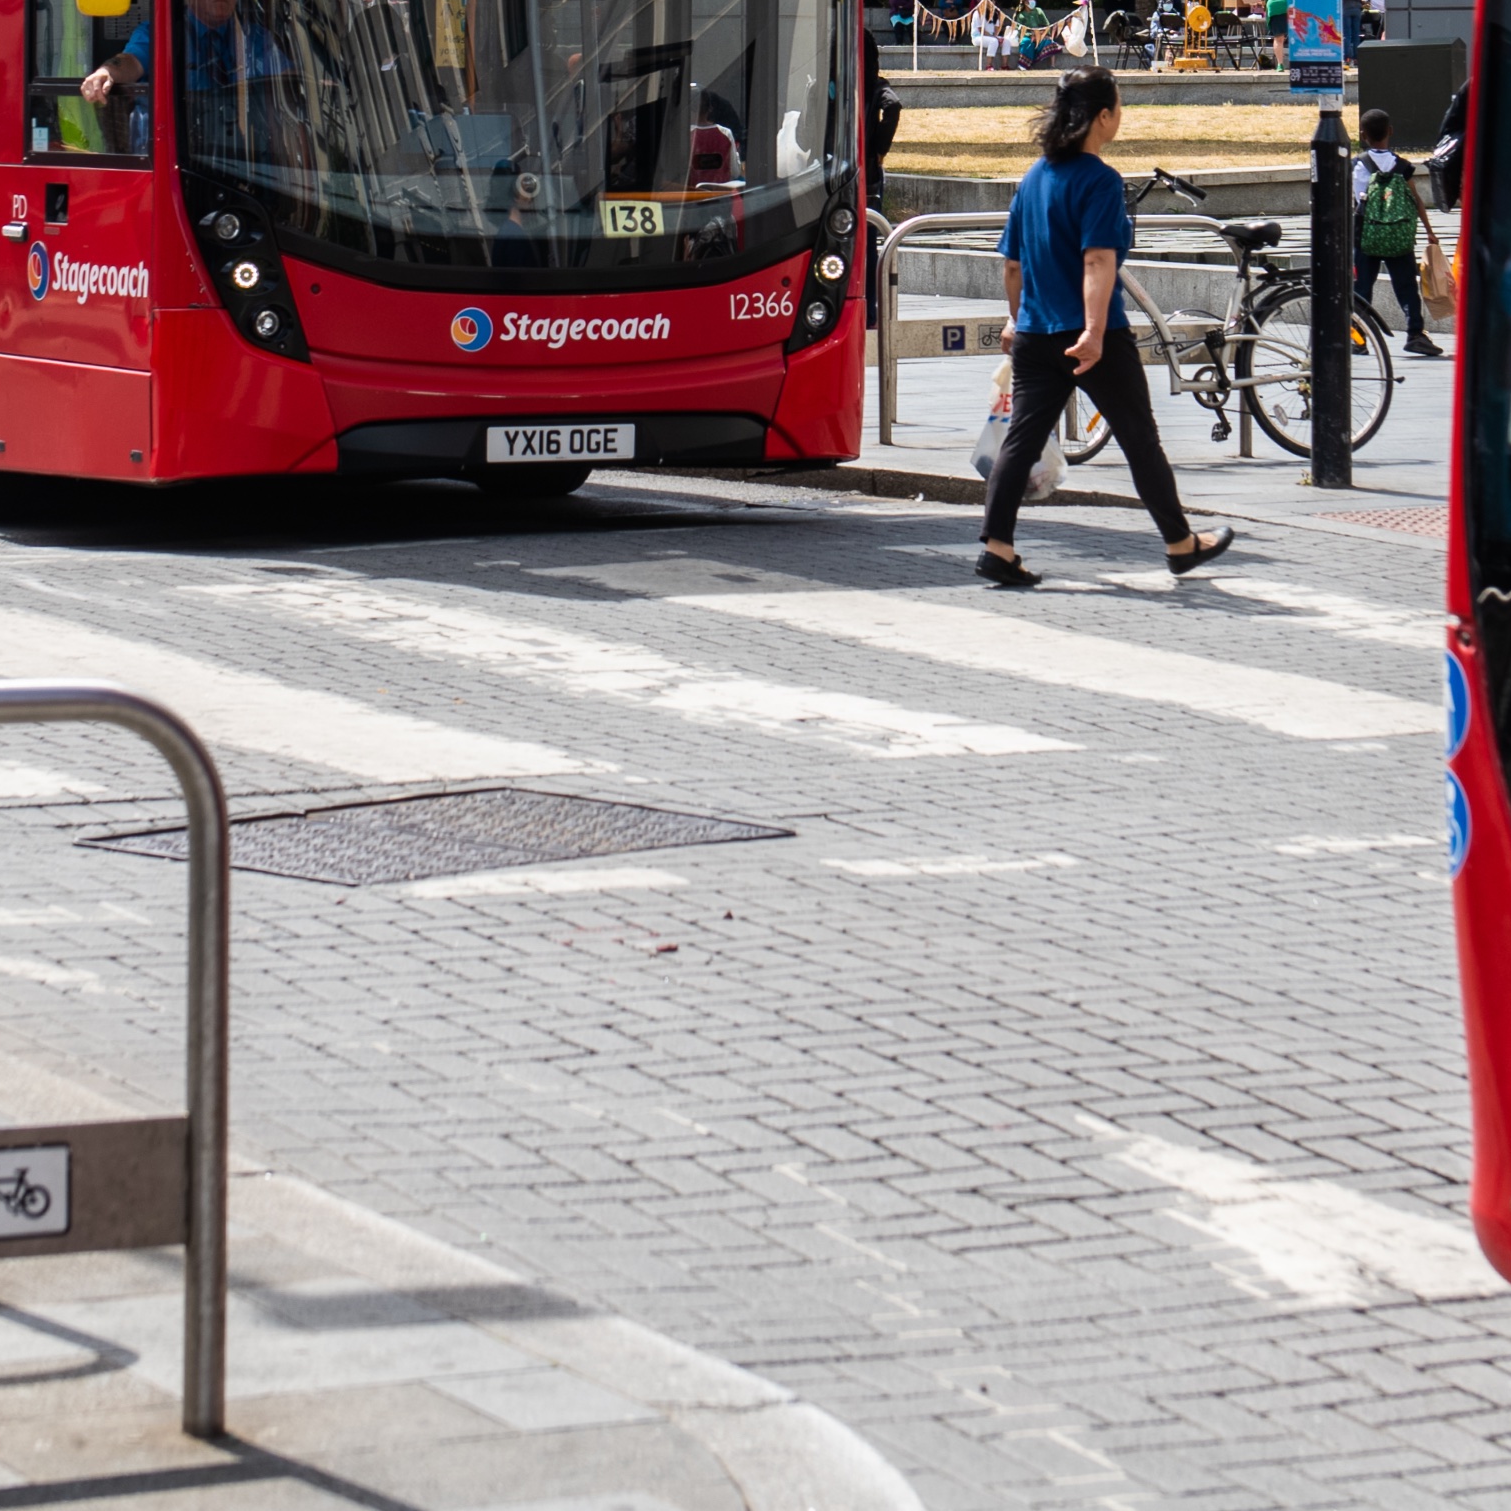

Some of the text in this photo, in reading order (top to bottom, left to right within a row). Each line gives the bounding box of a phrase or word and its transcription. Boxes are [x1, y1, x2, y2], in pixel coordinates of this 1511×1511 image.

[12, 194, 28, 219] PD
[610, 205, 657, 235] 138
[52, 251, 150, 305] Stagecoach
[729, 290, 794, 321] 12366
[499, 312, 671, 349] Stagecoach
[946, 328, 961, 348] P
[504, 427, 619, 456] YX16 OGE
